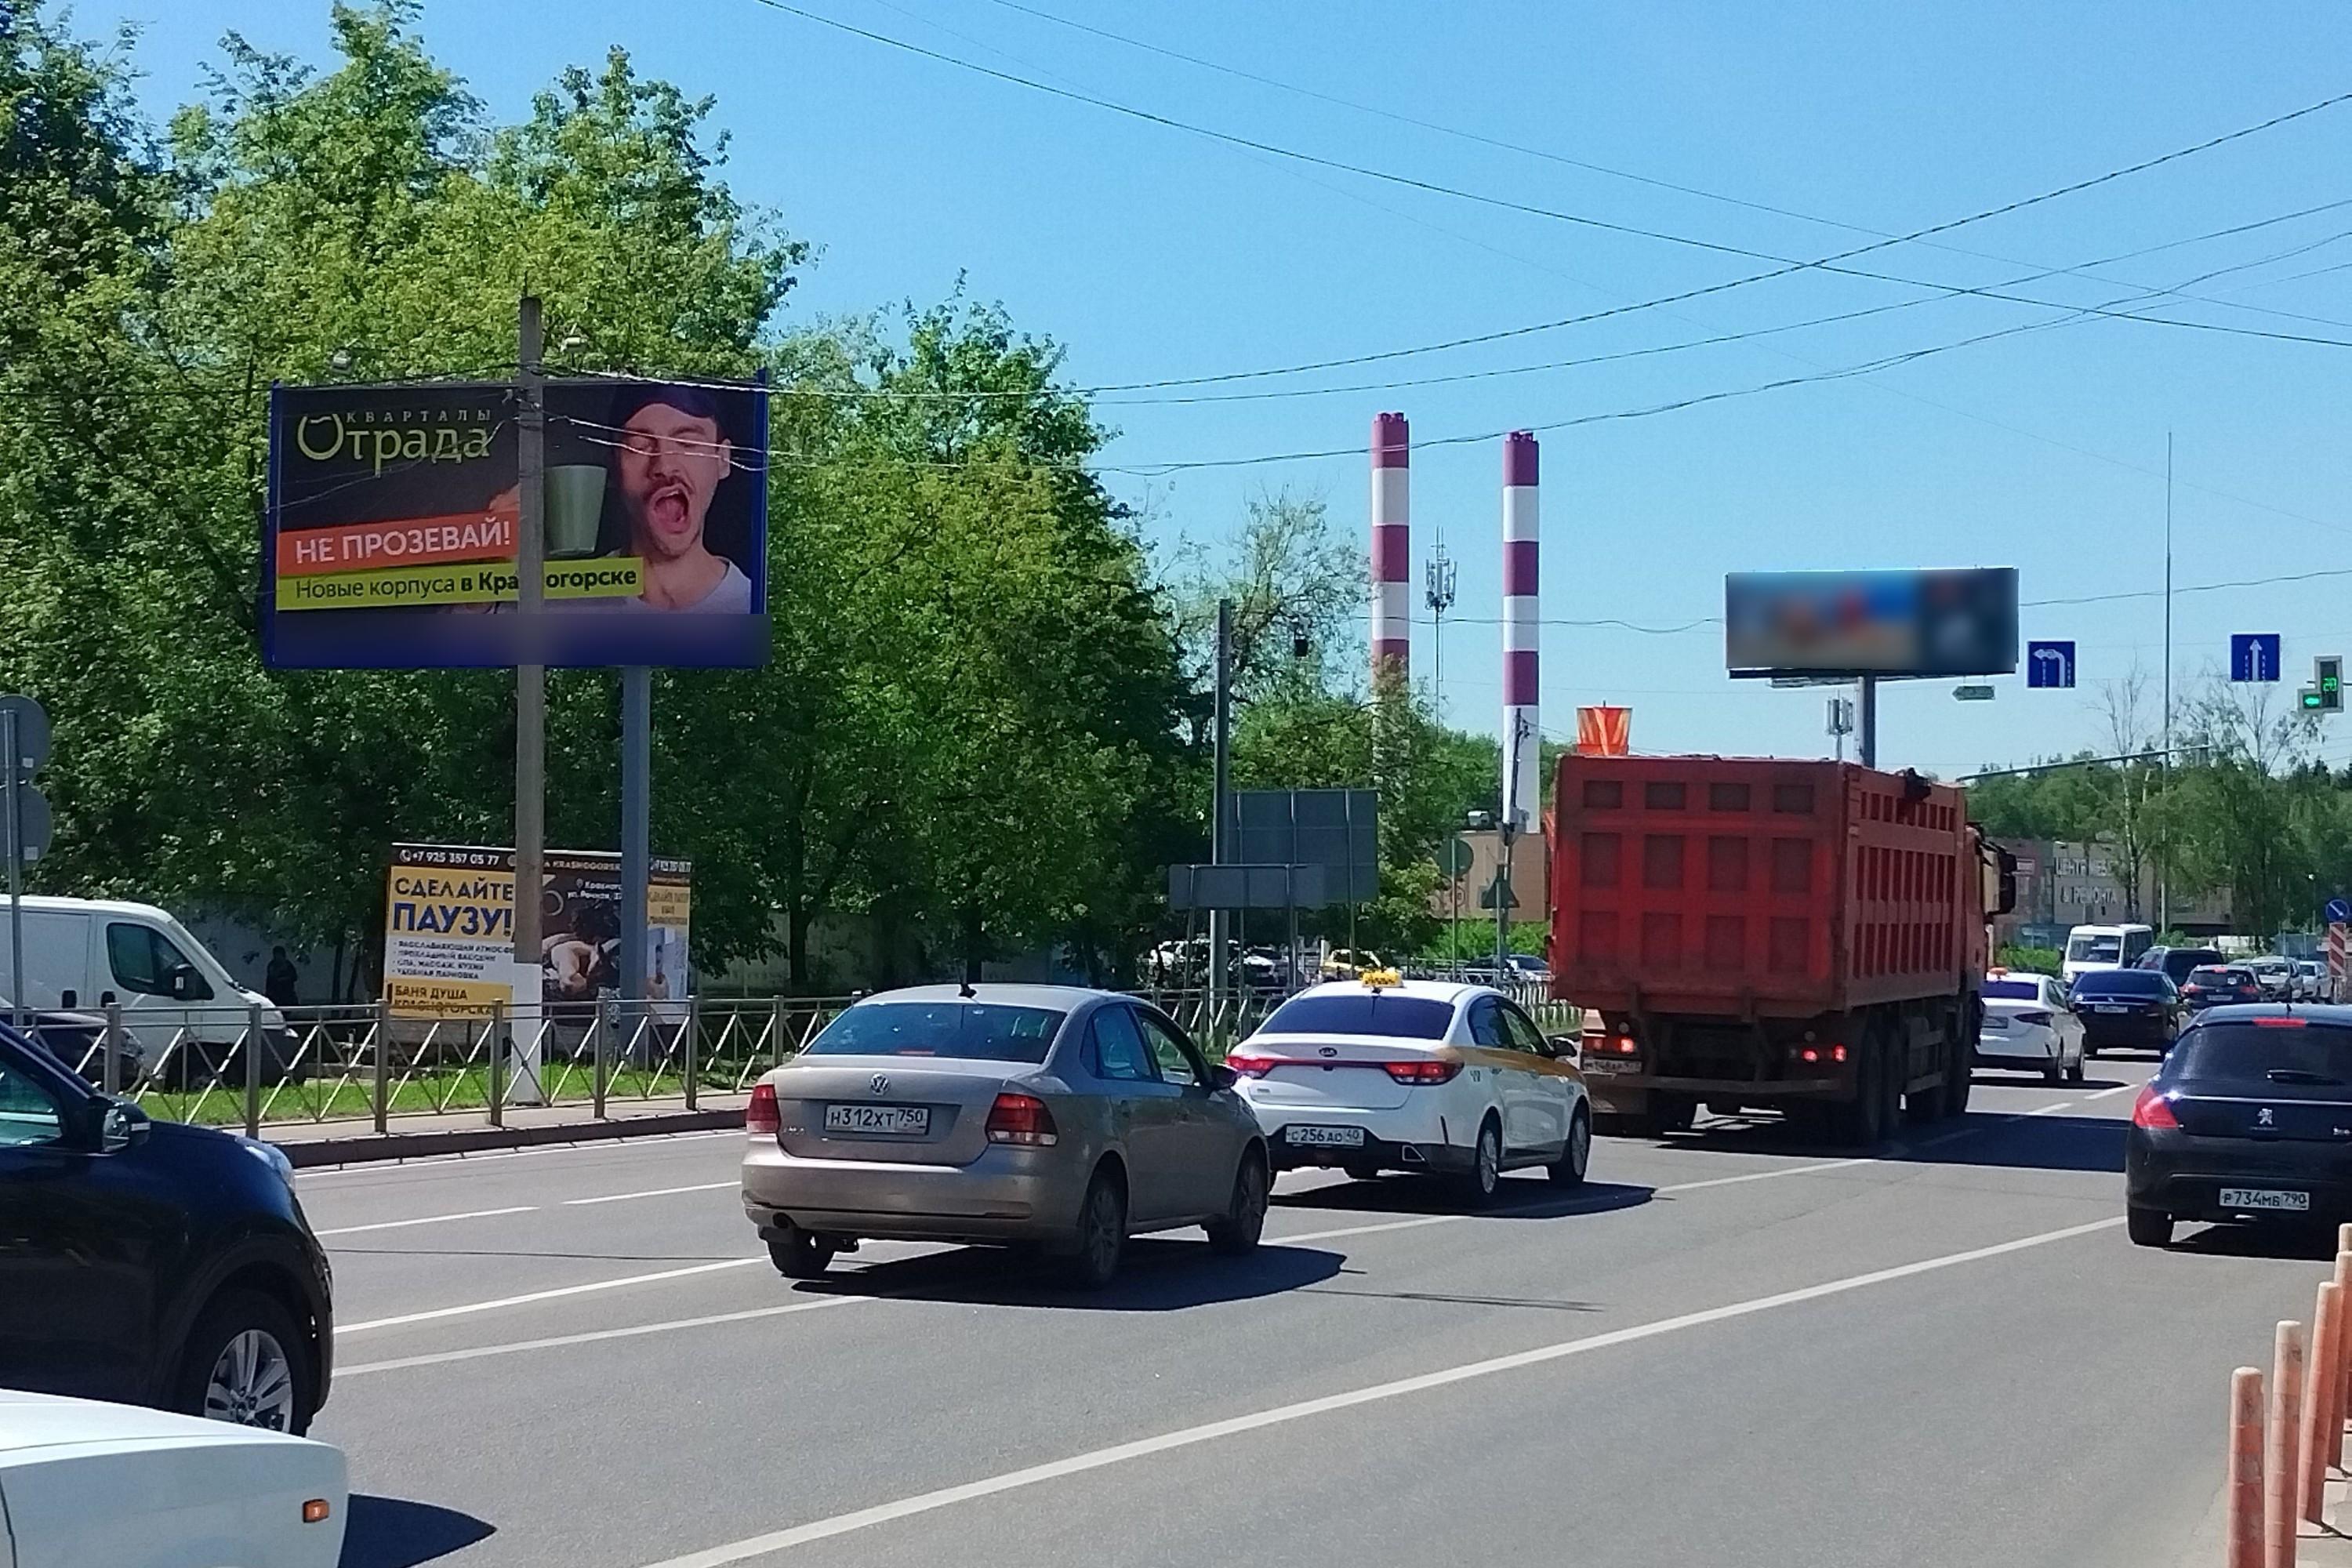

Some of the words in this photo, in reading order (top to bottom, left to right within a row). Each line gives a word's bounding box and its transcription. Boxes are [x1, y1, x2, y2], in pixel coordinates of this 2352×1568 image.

[346, 408, 492, 424] КВАРТАЛЫ
[297, 412, 490, 479] Отрада
[296, 537, 336, 564] НЕ
[342, 516, 510, 561] ПРОЗЕВАЙ!
[296, 580, 364, 599] Новые
[369, 577, 455, 599] корпуса
[460, 576, 473, 592] в
[478, 569, 637, 596] Краогорске
[426, 851, 446, 863] 925
[449, 852, 467, 864] 357
[470, 854, 485, 865] 05
[487, 855, 500, 866] 77
[394, 877, 514, 902] СДЕЛАЙТЕ
[393, 902, 513, 937] ПАУЗУ!
[394, 985, 427, 999] БАНЯ
[430, 987, 469, 1001] ДУША
[898, 1109, 924, 1123] 750
[2282, 1192, 2307, 1204] 790
